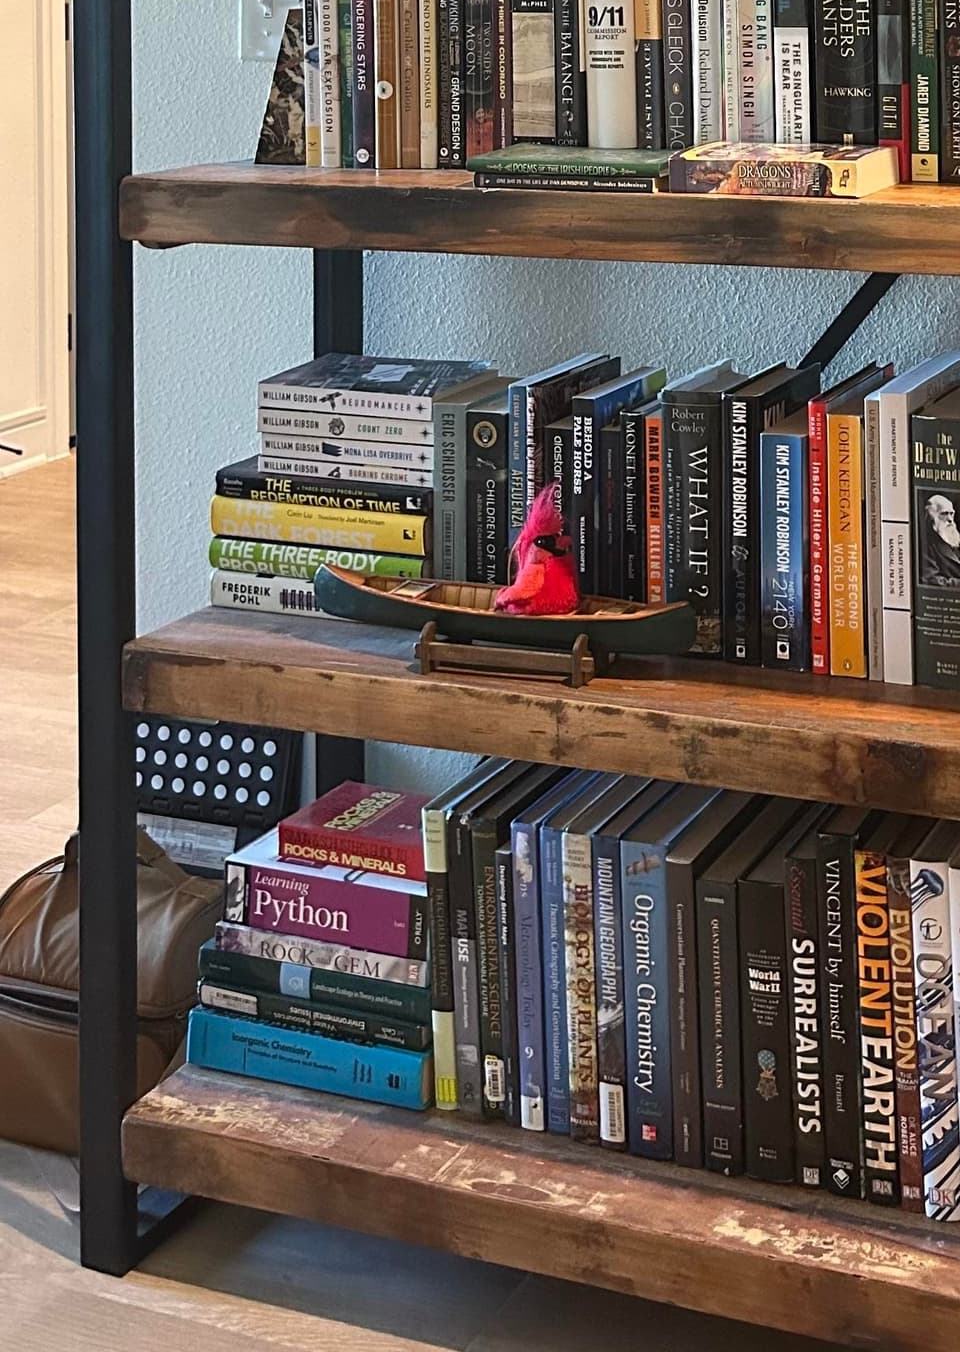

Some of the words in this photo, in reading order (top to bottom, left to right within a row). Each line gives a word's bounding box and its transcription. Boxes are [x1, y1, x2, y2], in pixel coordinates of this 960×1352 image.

[588, 6, 624, 27] 9/11
[668, 11, 684, 74] GLEICK
[742, 24, 754, 68] SIMON
[357, 54, 366, 91] STARS
[560, 32, 574, 104] BALANCE
[744, 76, 754, 118] SINGH
[824, 88, 872, 97] HAWKING
[738, 164, 791, 179] DRAGONS
[441, 412, 455, 438] ERIC
[671, 422, 706, 434] Cowley
[672, 407, 705, 420] Robert
[732, 401, 746, 423] KIM
[732, 426, 747, 476] STANLEY
[838, 424, 849, 464] JOHN
[265, 478, 292, 493] THE
[442, 442, 456, 503] SCHLOSSER
[512, 470, 522, 528] AFFLUENZA
[688, 448, 708, 541] WHAT
[732, 479, 748, 537] ROBINSON
[838, 468, 850, 532] KEEGAN
[220, 540, 255, 560] THE
[261, 544, 382, 572] THREE-BODY
[688, 550, 708, 576] IF
[834, 544, 844, 594] WORLD
[222, 582, 272, 597] FREDERIK
[232, 594, 260, 606] POHL
[688, 586, 709, 598] ?
[834, 598, 844, 628] WAR
[284, 842, 327, 862] ROCKS
[330, 852, 340, 863] &
[342, 854, 406, 875] MINERALS
[254, 871, 310, 895] Learning
[598, 856, 615, 927] MOUNTAIN
[254, 889, 350, 933] Python
[629, 894, 655, 976] Organic
[856, 862, 892, 1036] VIOLENT
[260, 940, 315, 966] ROCK
[334, 956, 380, 978] GEM
[600, 930, 617, 1005] GEOGRAPHY
[748, 968, 781, 981] World
[890, 907, 916, 1070] EVOLUTION
[633, 982, 657, 1094] Chemistry
[792, 938, 821, 1134] SURREALISTS
[916, 954, 955, 1100] OCEAN
[861, 1036, 896, 1172] EARTH
